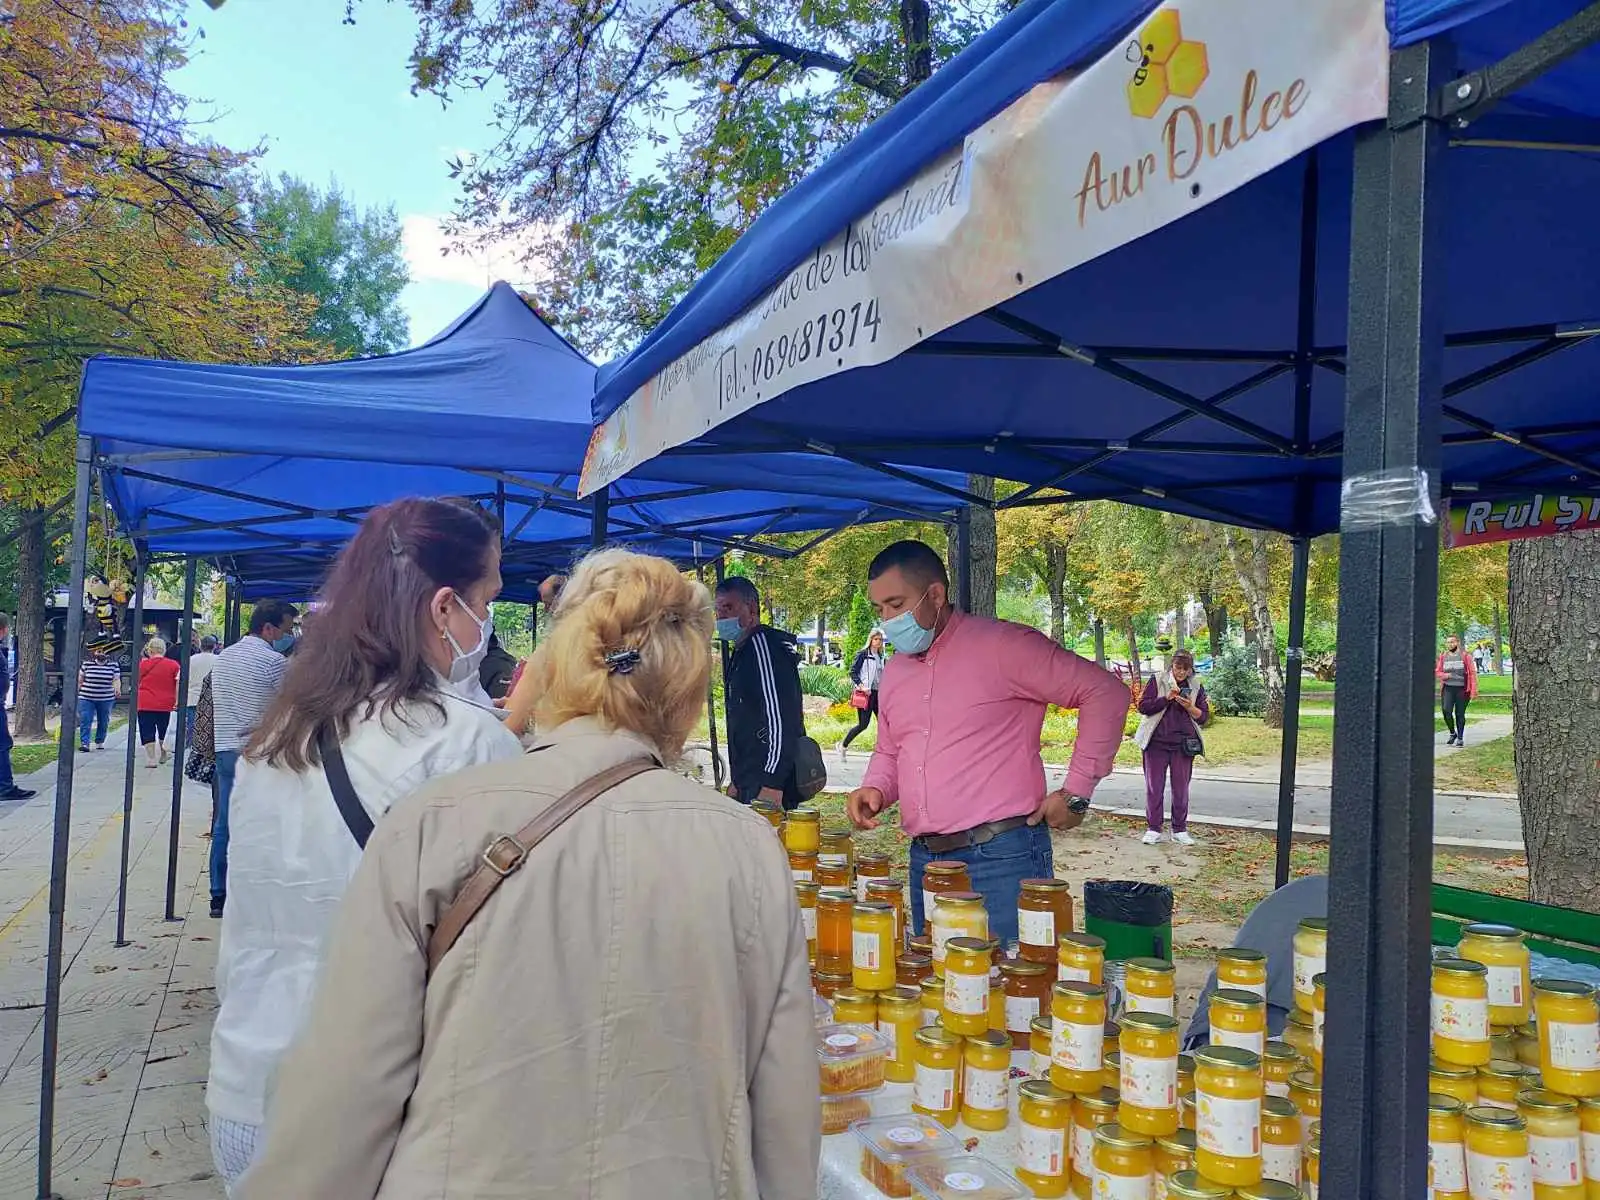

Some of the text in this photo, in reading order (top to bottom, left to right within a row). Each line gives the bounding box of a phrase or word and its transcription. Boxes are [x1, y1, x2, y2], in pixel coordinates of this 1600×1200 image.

[1073, 69, 1312, 229] Aur Dulce
[806, 246, 838, 292] de
[752, 297, 882, 386] 069681314
[1464, 494, 1543, 535] R-ul
